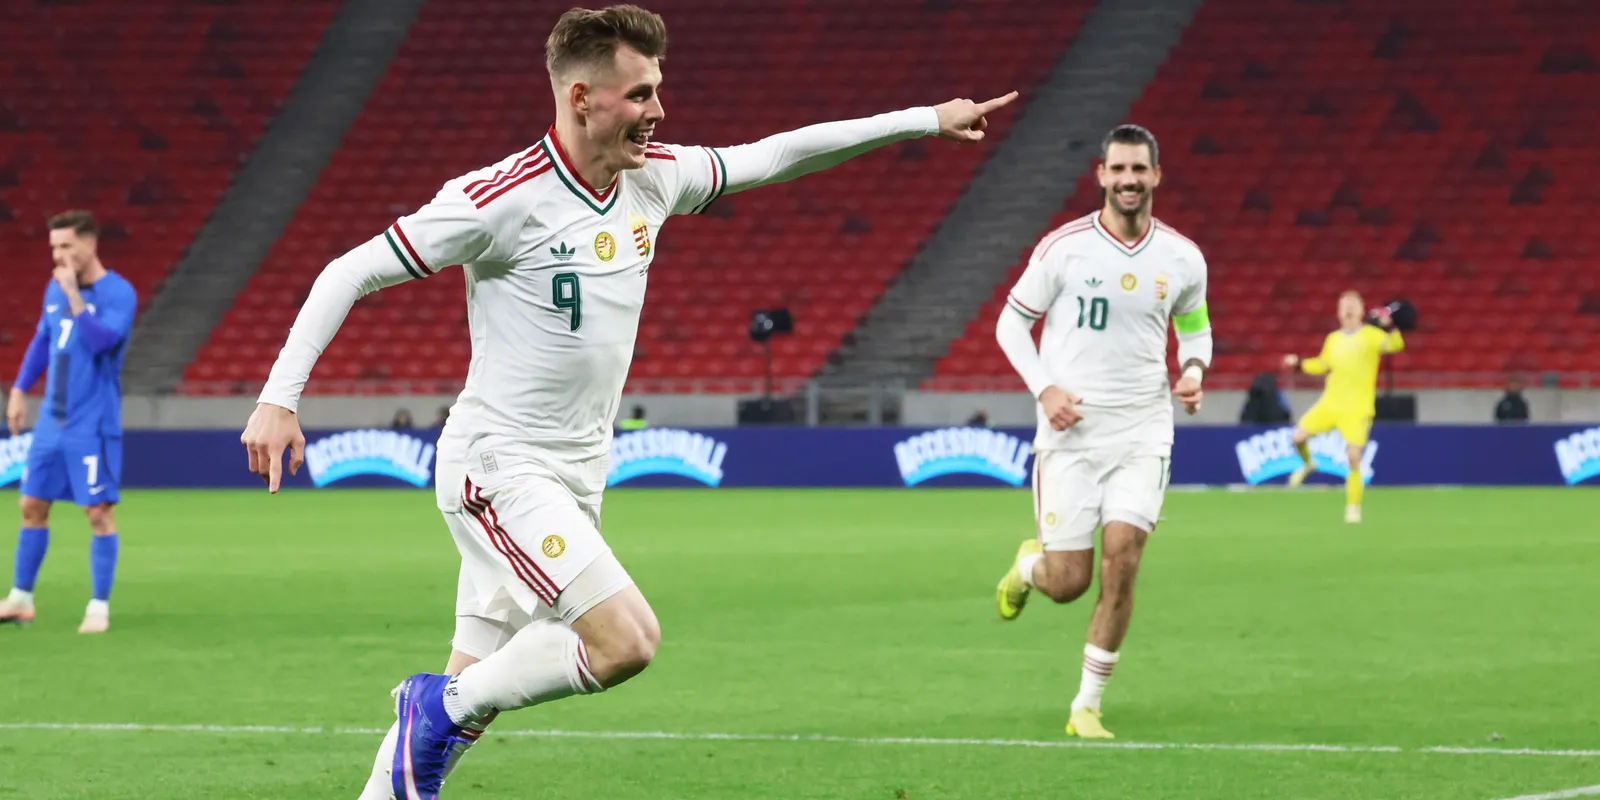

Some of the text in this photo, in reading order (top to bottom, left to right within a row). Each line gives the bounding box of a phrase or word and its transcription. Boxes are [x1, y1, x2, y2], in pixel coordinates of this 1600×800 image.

[552, 272, 582, 333] 9
[1076, 296, 1109, 331] 10
[57, 318, 74, 350] 7
